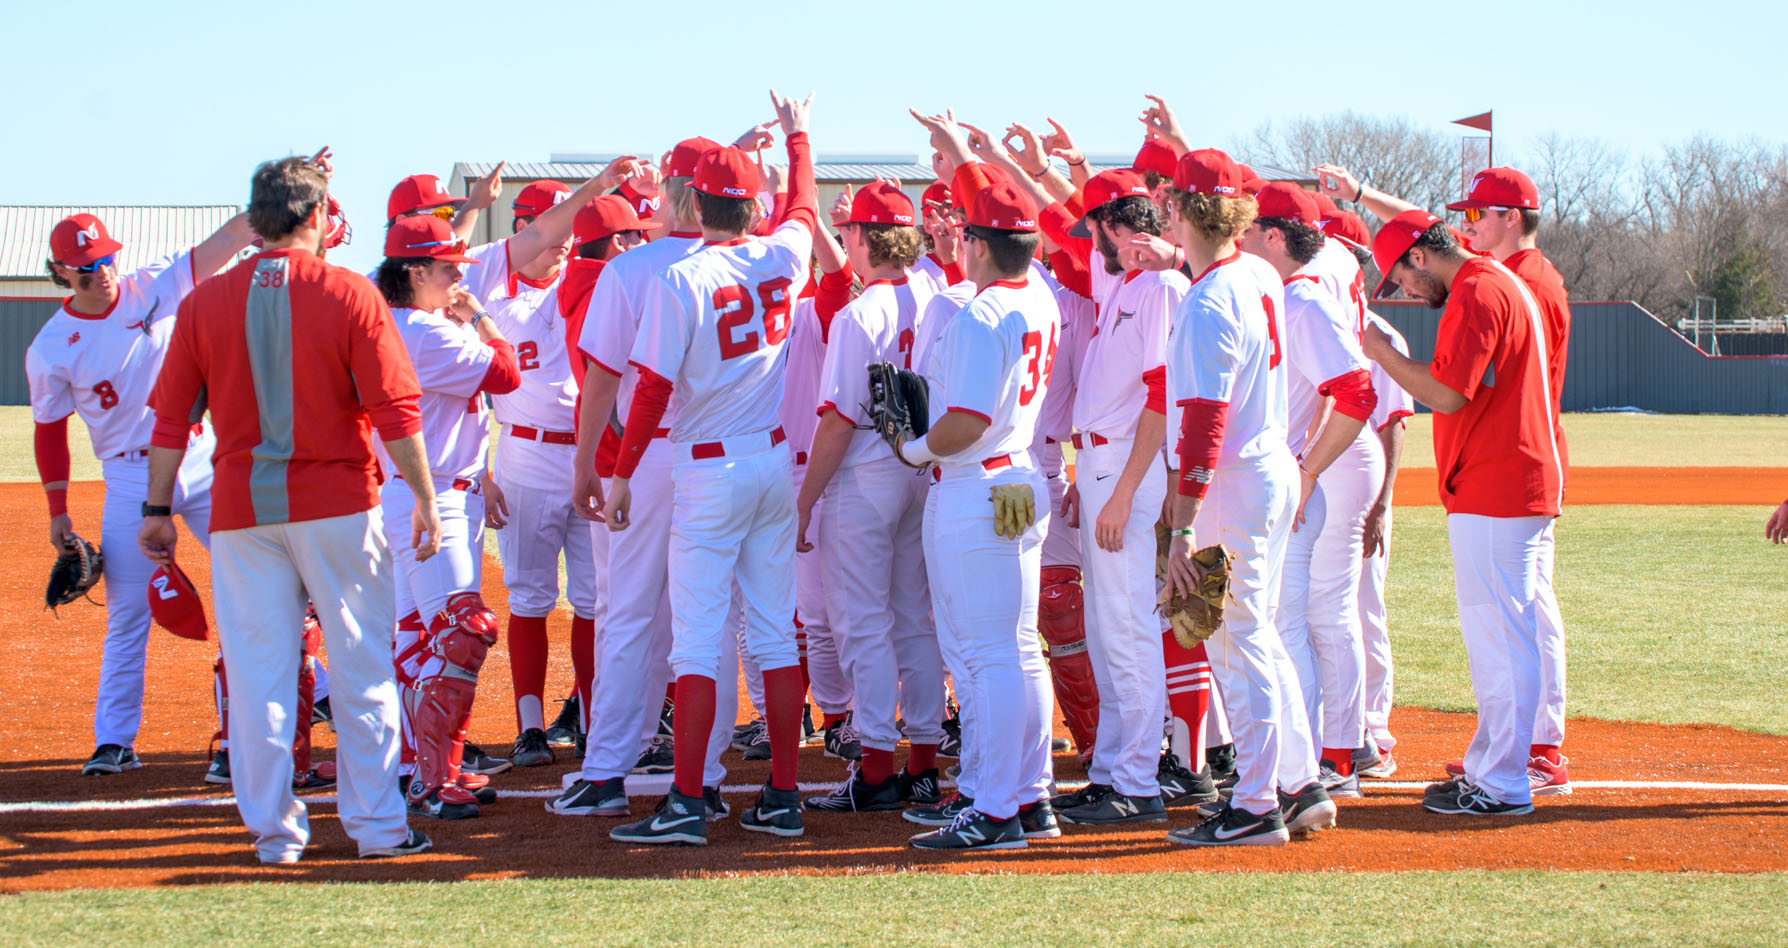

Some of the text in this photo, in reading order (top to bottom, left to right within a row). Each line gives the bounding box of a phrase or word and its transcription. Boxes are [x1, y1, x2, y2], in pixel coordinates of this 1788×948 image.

[258, 271, 284, 289] 38
[712, 276, 793, 361] 28
[92, 380, 119, 410] 8
[152, 575, 180, 600] N
